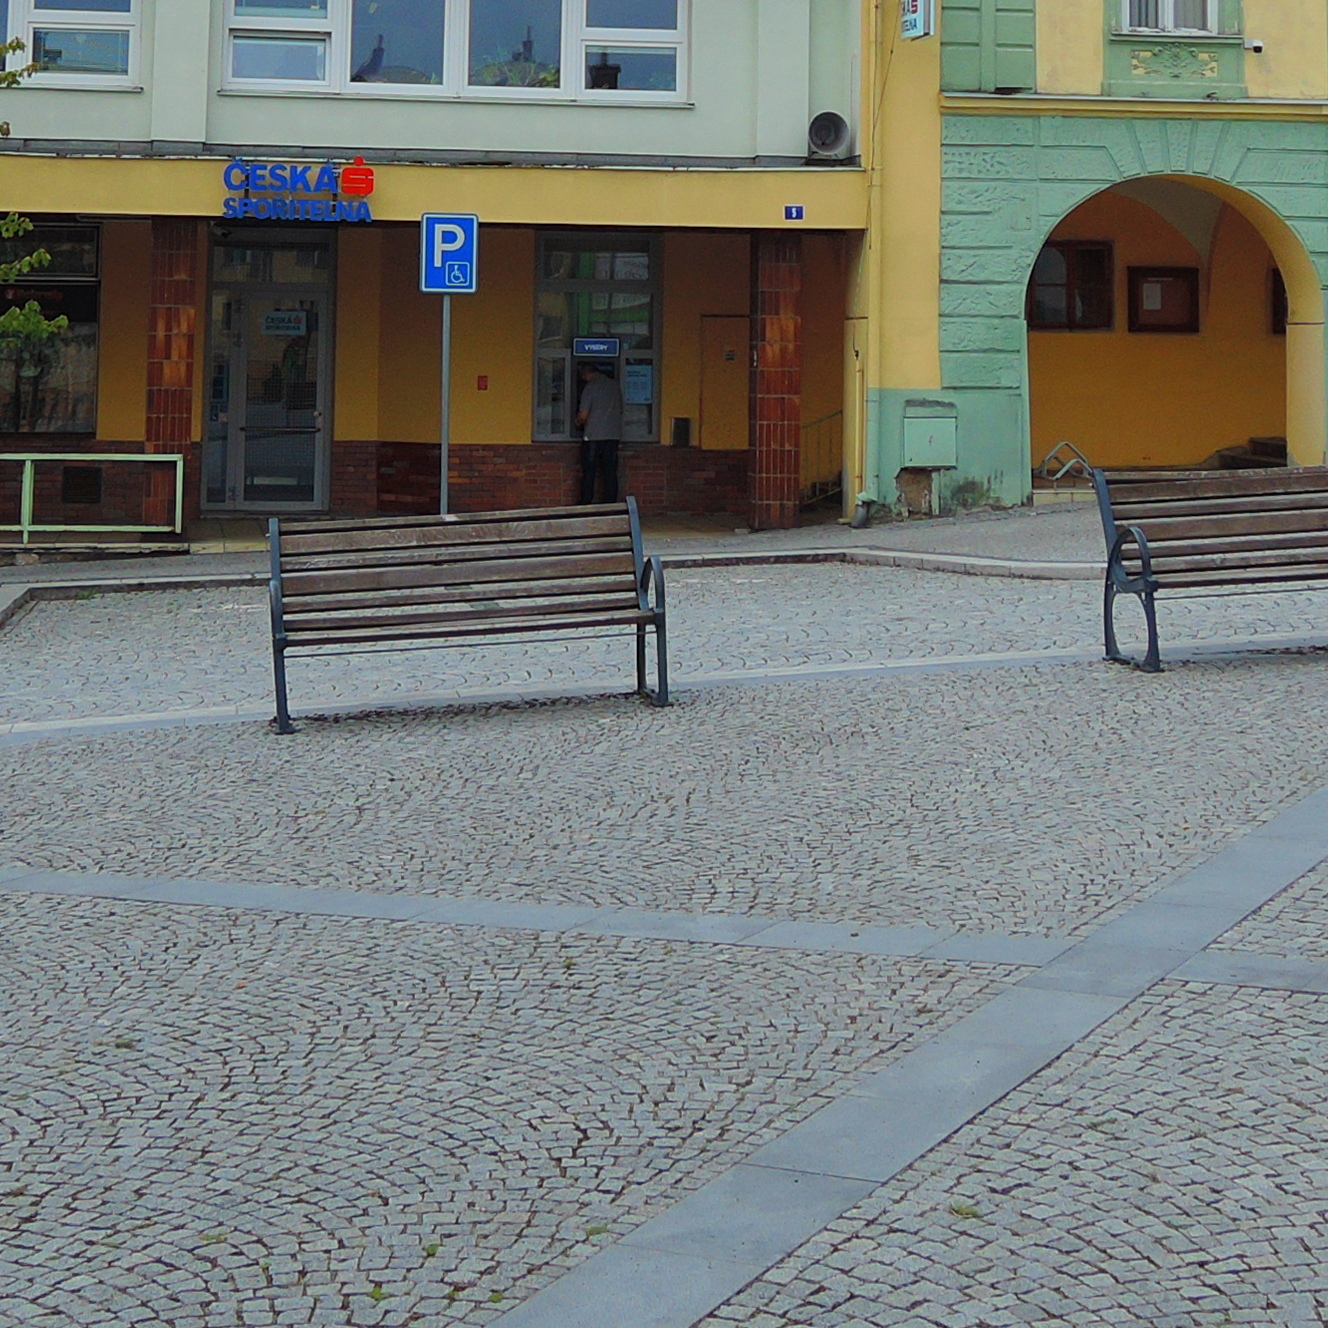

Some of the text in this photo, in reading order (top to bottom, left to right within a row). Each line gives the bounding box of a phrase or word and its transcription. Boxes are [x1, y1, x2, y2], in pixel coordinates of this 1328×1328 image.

[223, 157, 339, 195] ČESKÁ
[222, 196, 372, 223] SPOŘITELNA
[434, 224, 465, 267] P
